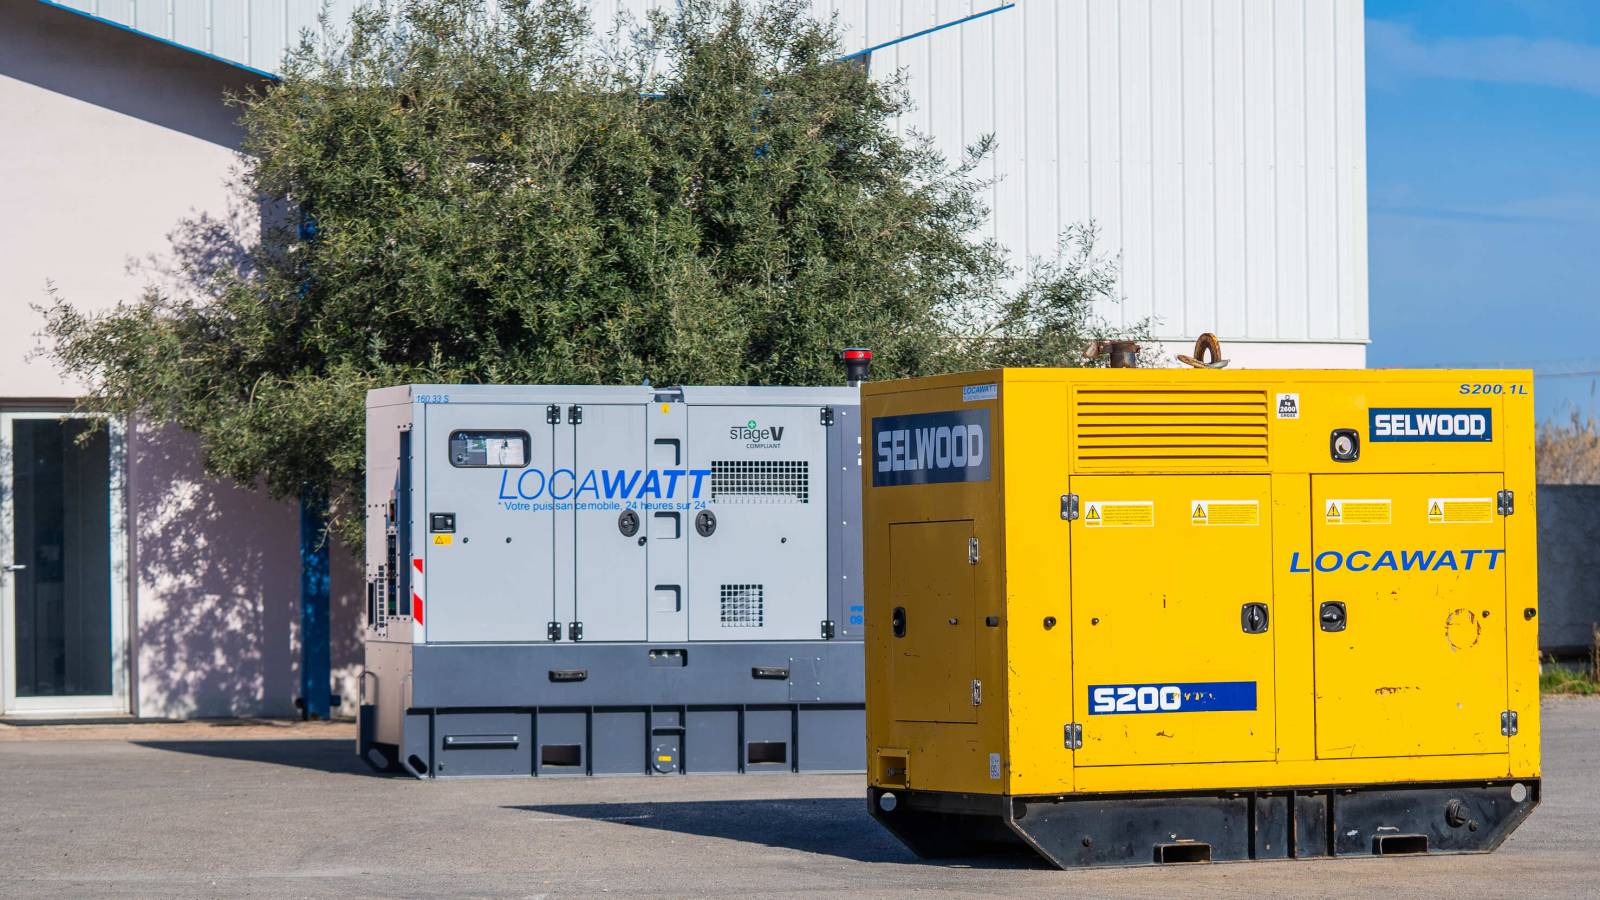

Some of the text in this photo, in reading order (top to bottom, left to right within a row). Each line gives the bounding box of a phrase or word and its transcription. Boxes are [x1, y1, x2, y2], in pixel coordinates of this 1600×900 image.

[1459, 383, 1529, 395] S200.1L
[1375, 414, 1486, 436] SELWOOD
[878, 424, 984, 472] SELWOOD
[499, 468, 712, 500] LOCAWATT
[504, 501, 530, 511] Votre
[626, 501, 637, 510] 24
[641, 501, 673, 510] heures
[676, 502, 691, 510] sur
[694, 501, 706, 510] 24
[1289, 549, 1505, 573] LOCAWATT
[1094, 686, 1181, 712] S200
